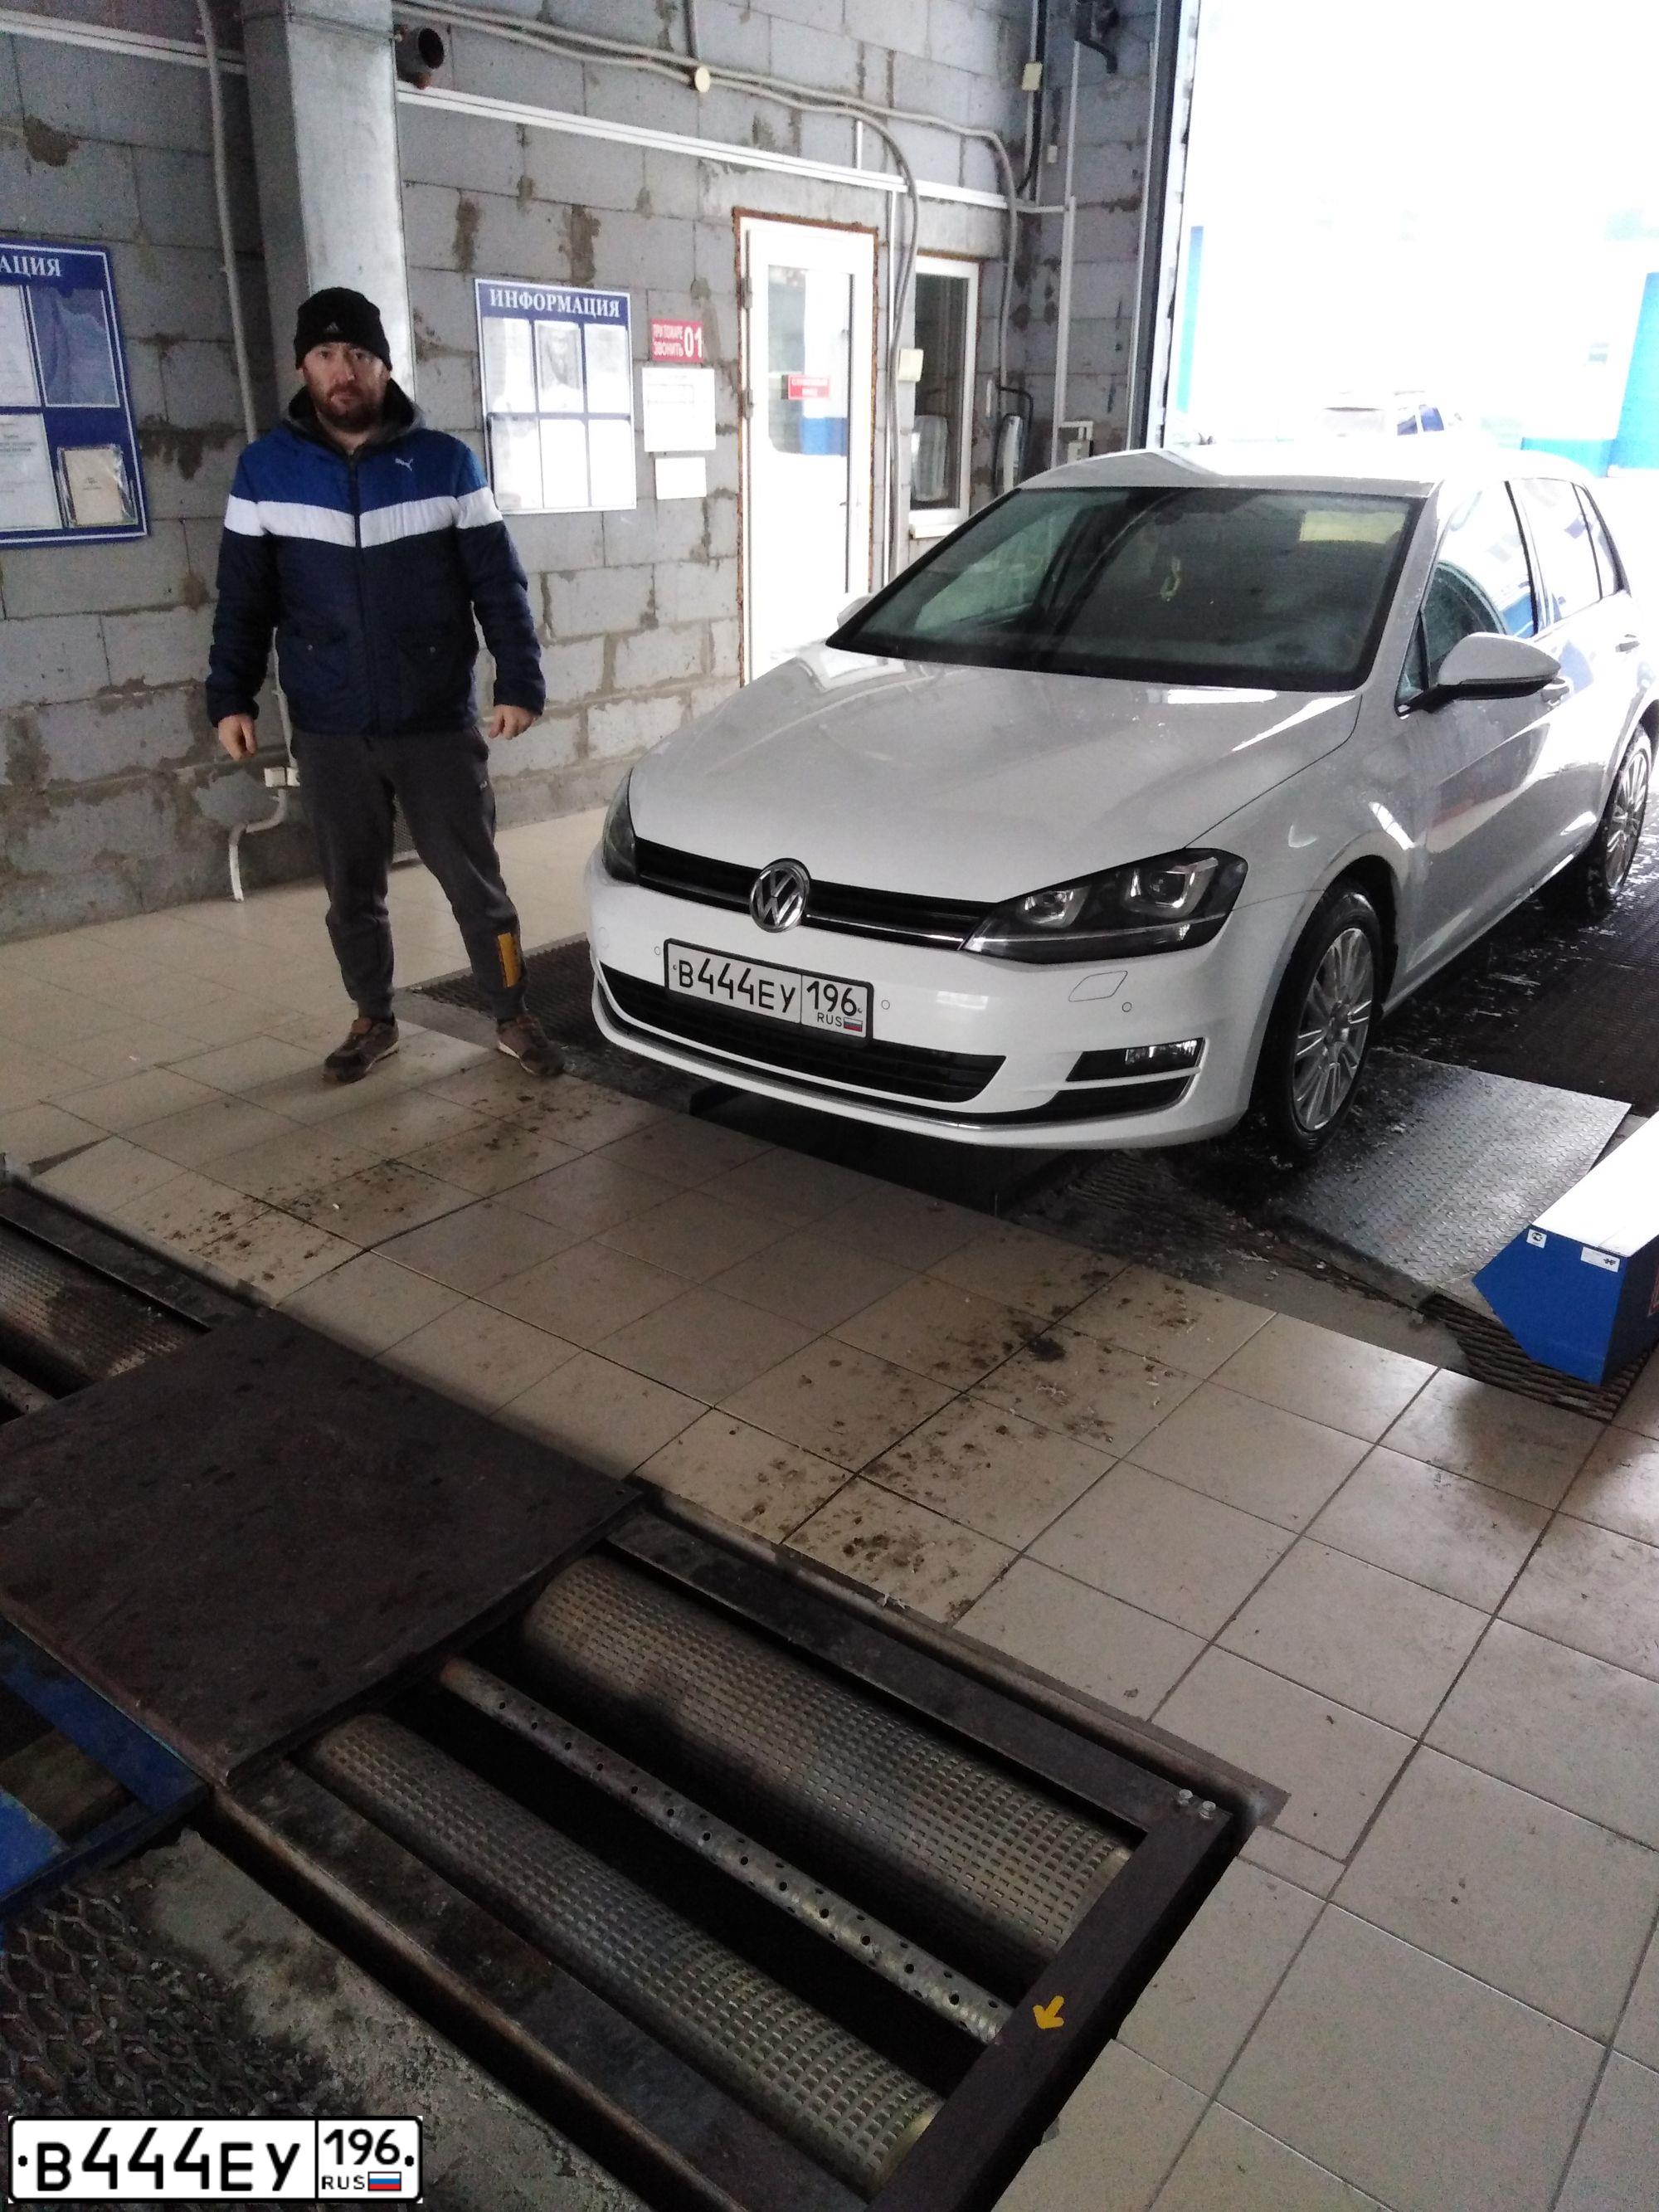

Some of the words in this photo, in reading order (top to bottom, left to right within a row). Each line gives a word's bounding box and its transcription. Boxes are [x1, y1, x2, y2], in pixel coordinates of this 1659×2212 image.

[489, 288, 620, 319] ИНФОРМАЦИЯ
[684, 326, 703, 358] 01
[806, 980, 858, 1016] 196
[816, 1011, 843, 1027] RUS
